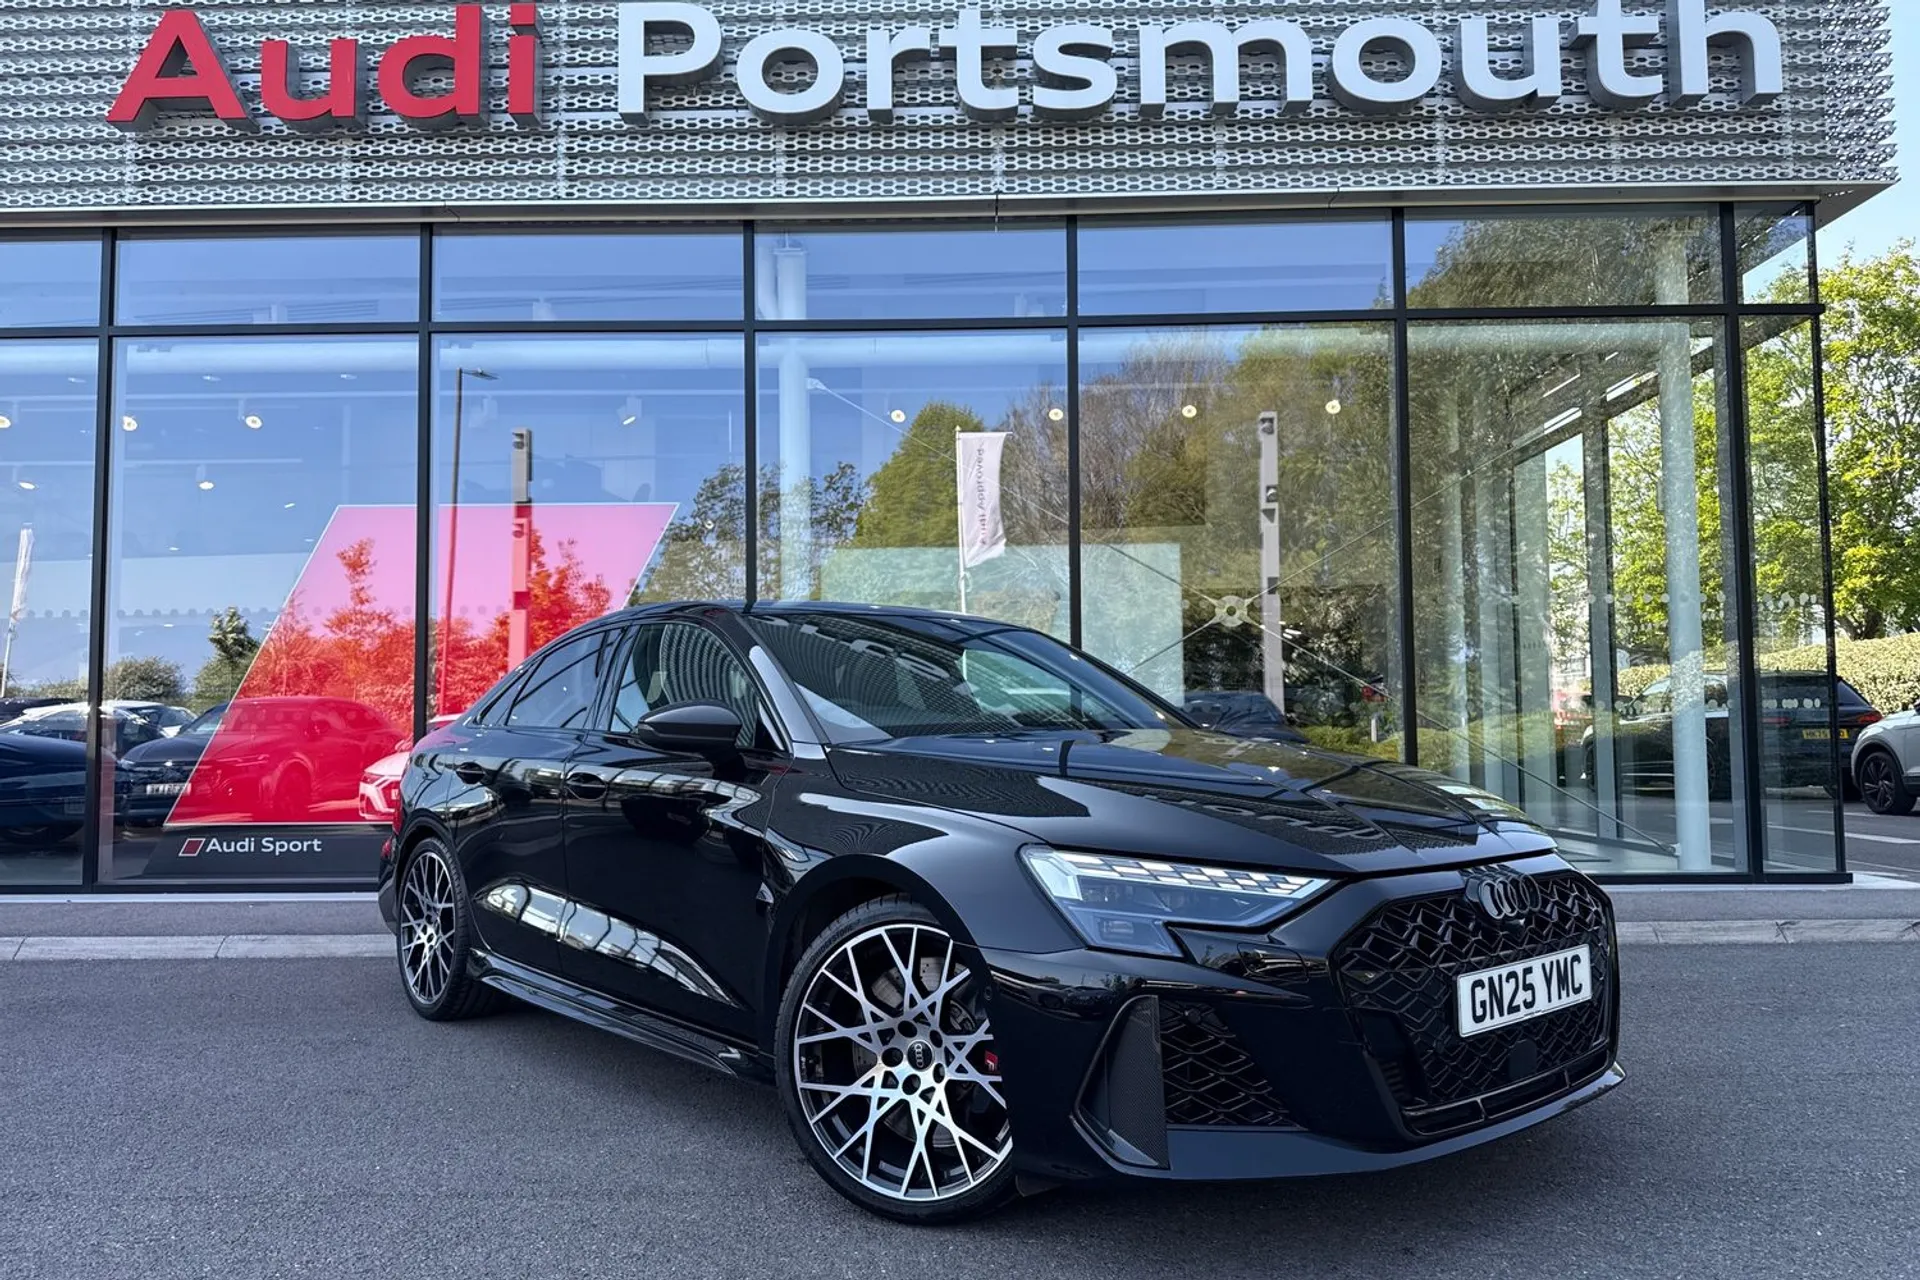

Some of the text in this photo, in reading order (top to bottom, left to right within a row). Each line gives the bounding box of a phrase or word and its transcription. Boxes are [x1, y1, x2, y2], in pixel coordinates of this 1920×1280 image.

[106, 0, 1783, 122] Audi Portsmouth
[205, 836, 323, 856] Audi Sport
[1470, 954, 1583, 1024] GN25 YMC
